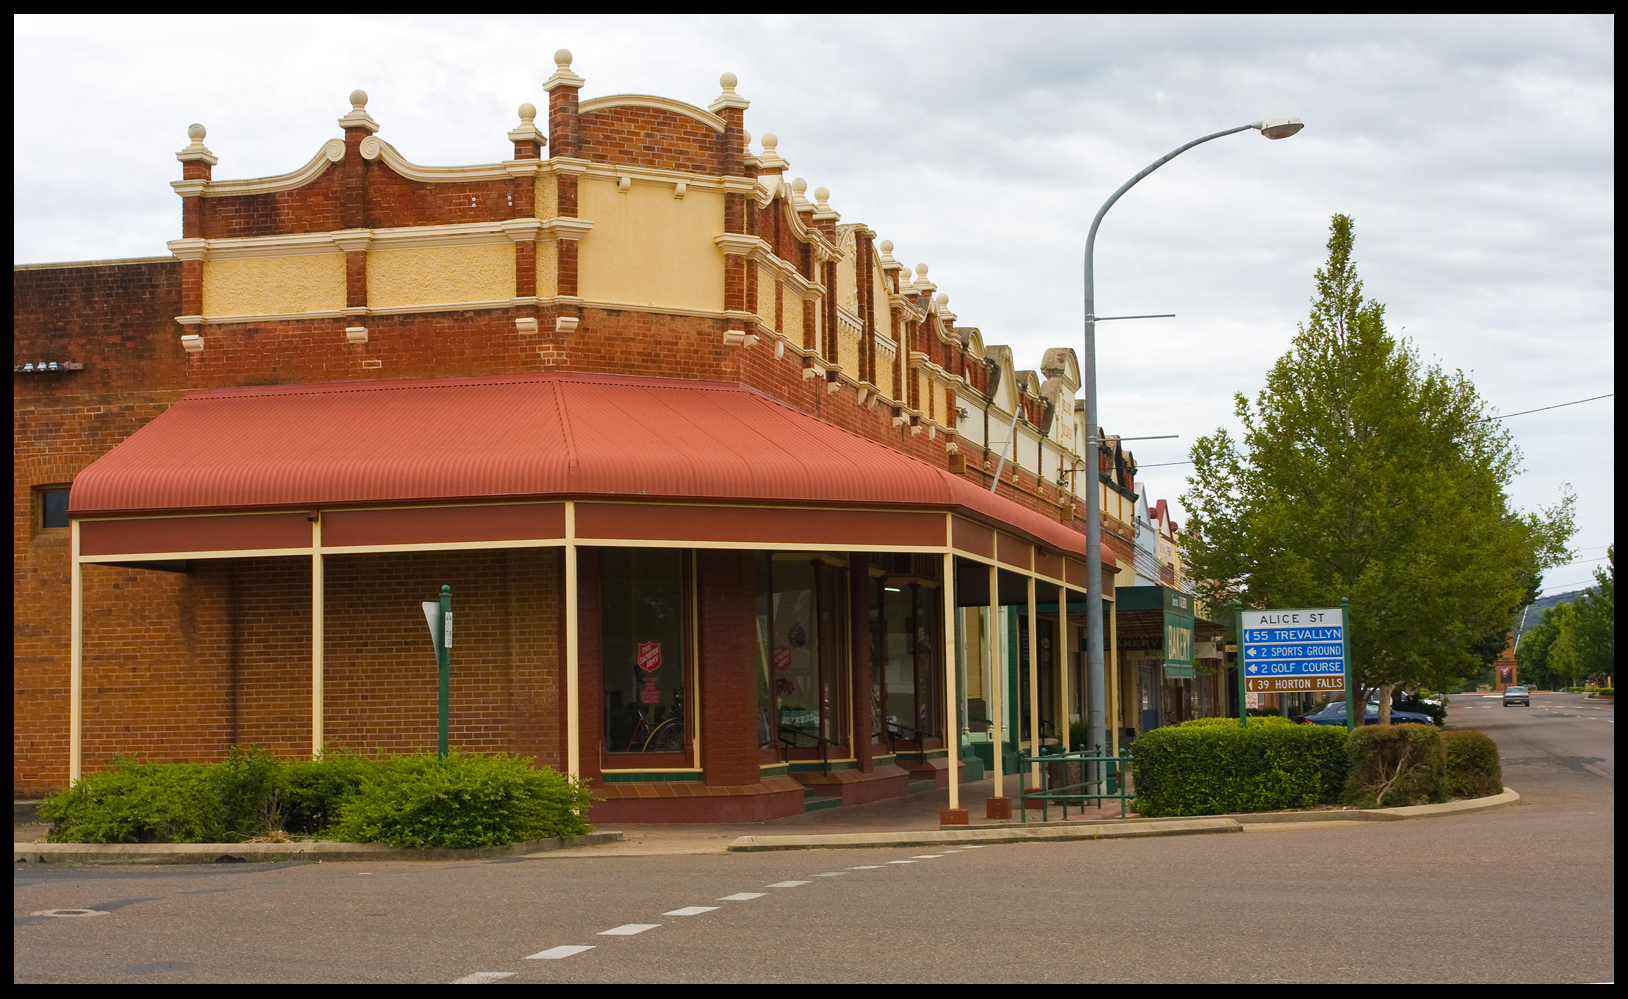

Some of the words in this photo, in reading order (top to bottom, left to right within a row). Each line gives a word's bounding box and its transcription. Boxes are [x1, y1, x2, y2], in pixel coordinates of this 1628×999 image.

[1260, 614, 1299, 624] ALICE
[1309, 613, 1325, 623] ST
[1253, 631, 1269, 641] 55
[1274, 630, 1341, 640] TREVALLYN
[642, 644, 652, 654] THE
[1168, 625, 1191, 662] BAKERY
[639, 645, 659, 665] SALVATION
[1261, 648, 1267, 657] 2
[1271, 647, 1303, 657] SPORTS
[1307, 646, 1341, 656] GROUND
[646, 654, 659, 669] ARMY
[1261, 665, 1268, 673] 2
[1271, 663, 1296, 673] GOLF
[1302, 662, 1341, 672] COURSE
[1257, 680, 1269, 690] 39
[1275, 679, 1311, 689] HORTON
[1317, 678, 1343, 688] FALLS
